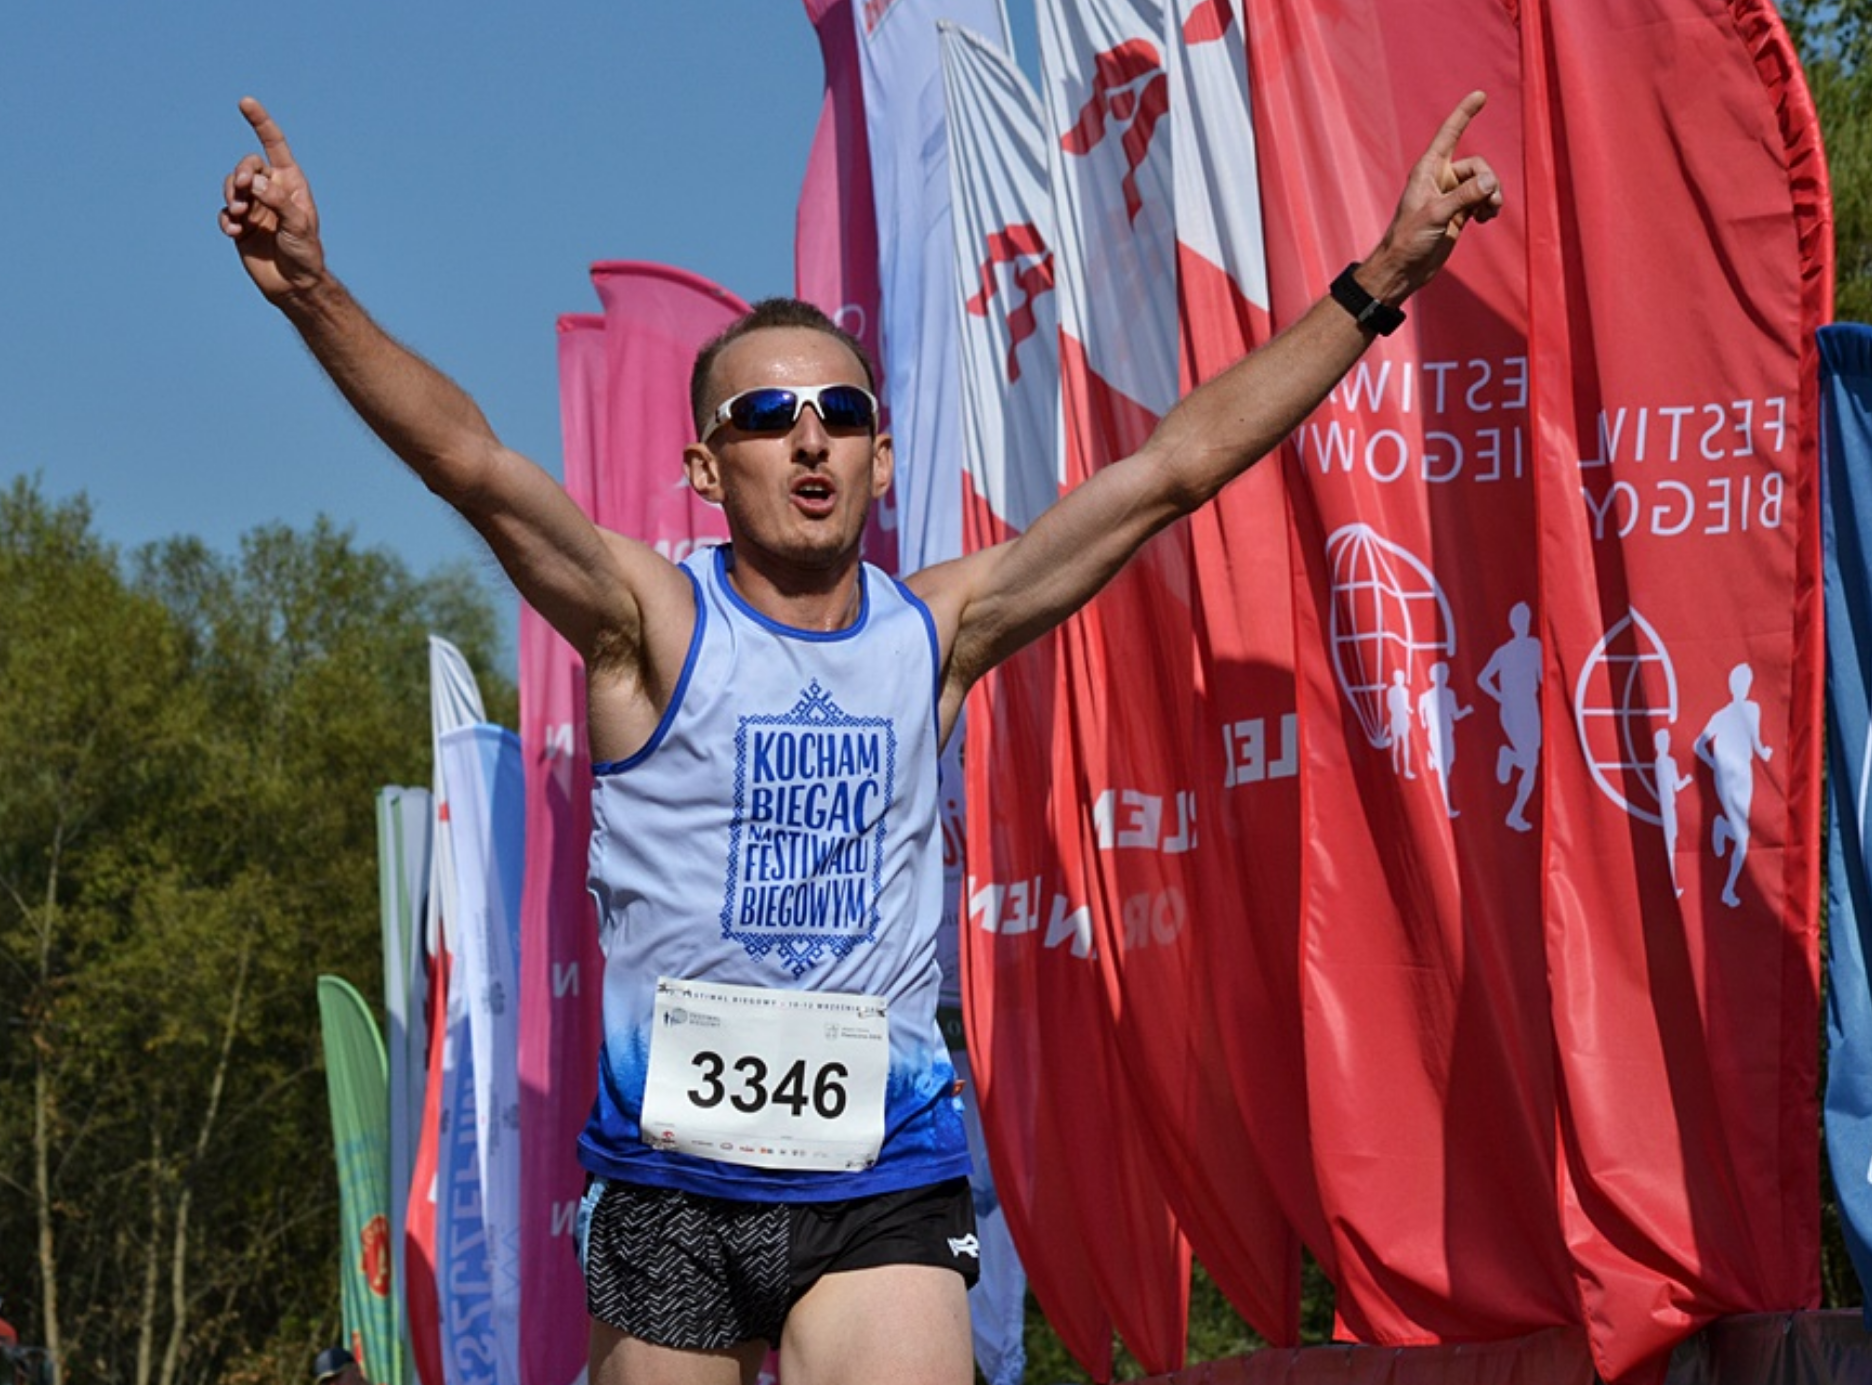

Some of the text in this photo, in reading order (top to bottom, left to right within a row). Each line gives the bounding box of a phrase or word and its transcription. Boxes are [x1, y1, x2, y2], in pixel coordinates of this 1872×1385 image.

[753, 731, 879, 784] KOCHAM
[744, 829, 869, 883] FESTIWALU
[748, 824, 772, 843] NA
[739, 877, 868, 929] BIEGOWYM
[686, 1050, 850, 1120] 3346
